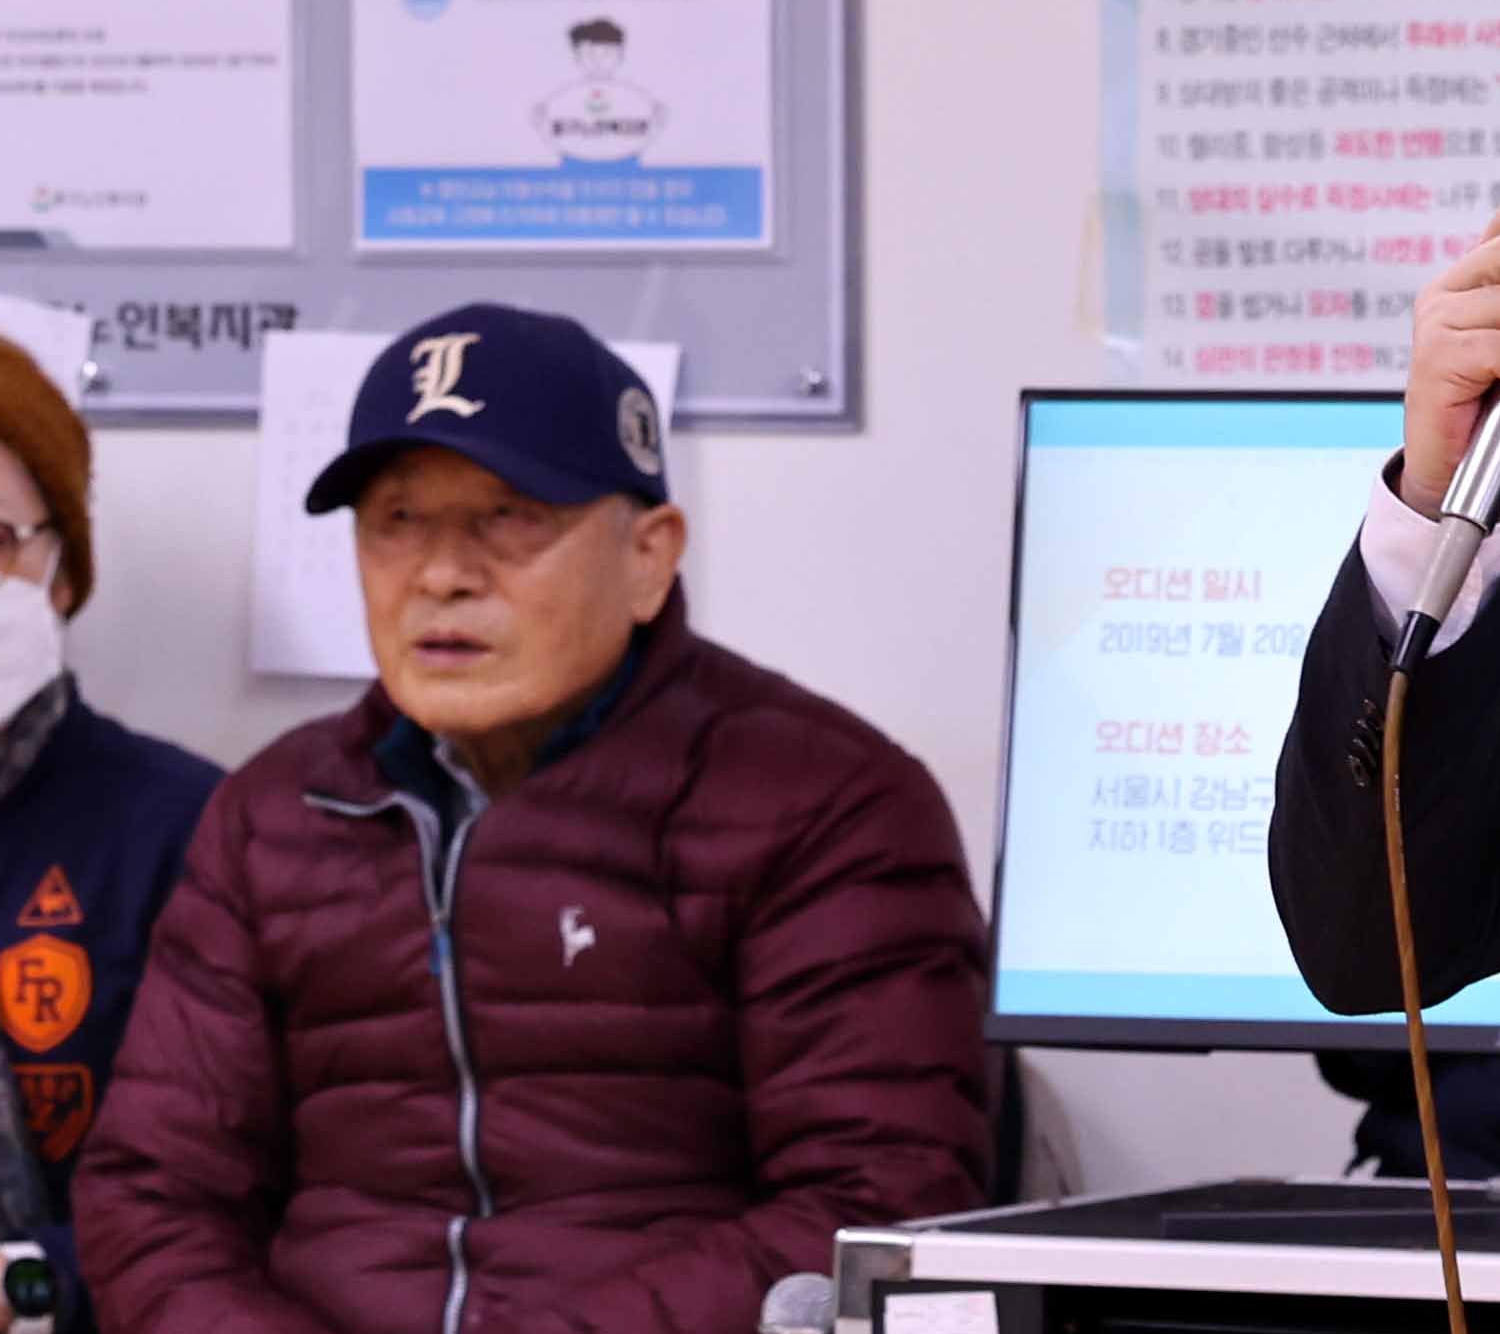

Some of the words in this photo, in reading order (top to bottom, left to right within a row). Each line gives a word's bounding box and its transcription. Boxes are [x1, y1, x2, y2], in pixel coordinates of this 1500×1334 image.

[407, 332, 486, 423] L
[1104, 567, 1192, 601] 오디션
[1202, 569, 1262, 602] 일시
[1099, 623, 1192, 657] 2019년
[1201, 624, 1244, 657] 7월
[1095, 721, 1184, 755] 오디션
[1195, 721, 1253, 755] 장소
[1092, 775, 1182, 810] 서울시
[1190, 775, 1275, 811] 강남구
[1089, 819, 1148, 853] 지하
[1159, 819, 1197, 854] 1층
